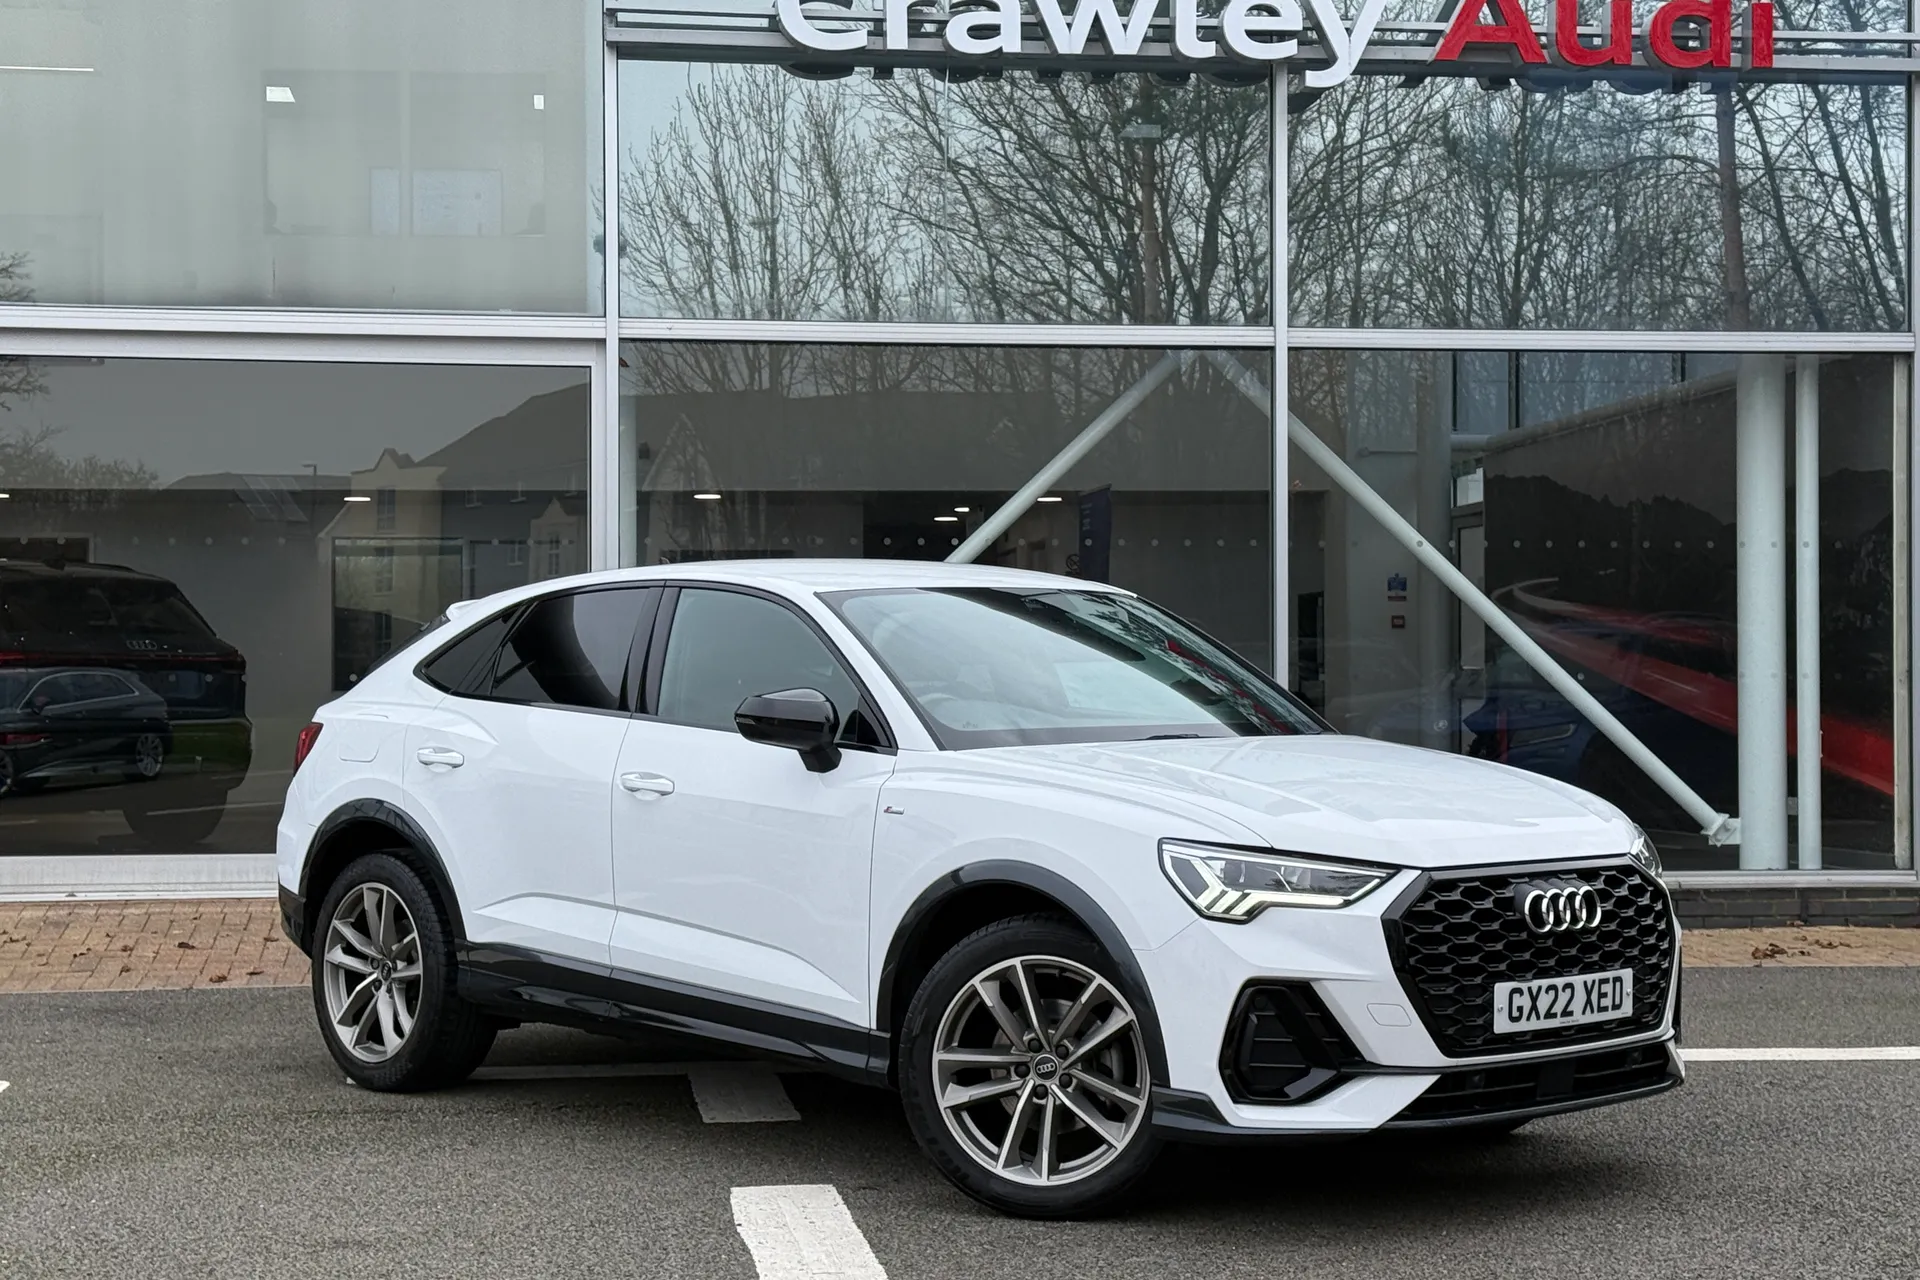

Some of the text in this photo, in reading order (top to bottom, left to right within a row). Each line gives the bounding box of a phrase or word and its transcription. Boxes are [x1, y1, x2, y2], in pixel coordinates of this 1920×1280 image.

[1433, 0, 1774, 68] Audi
[1508, 975, 1624, 1023] GX22 XED
